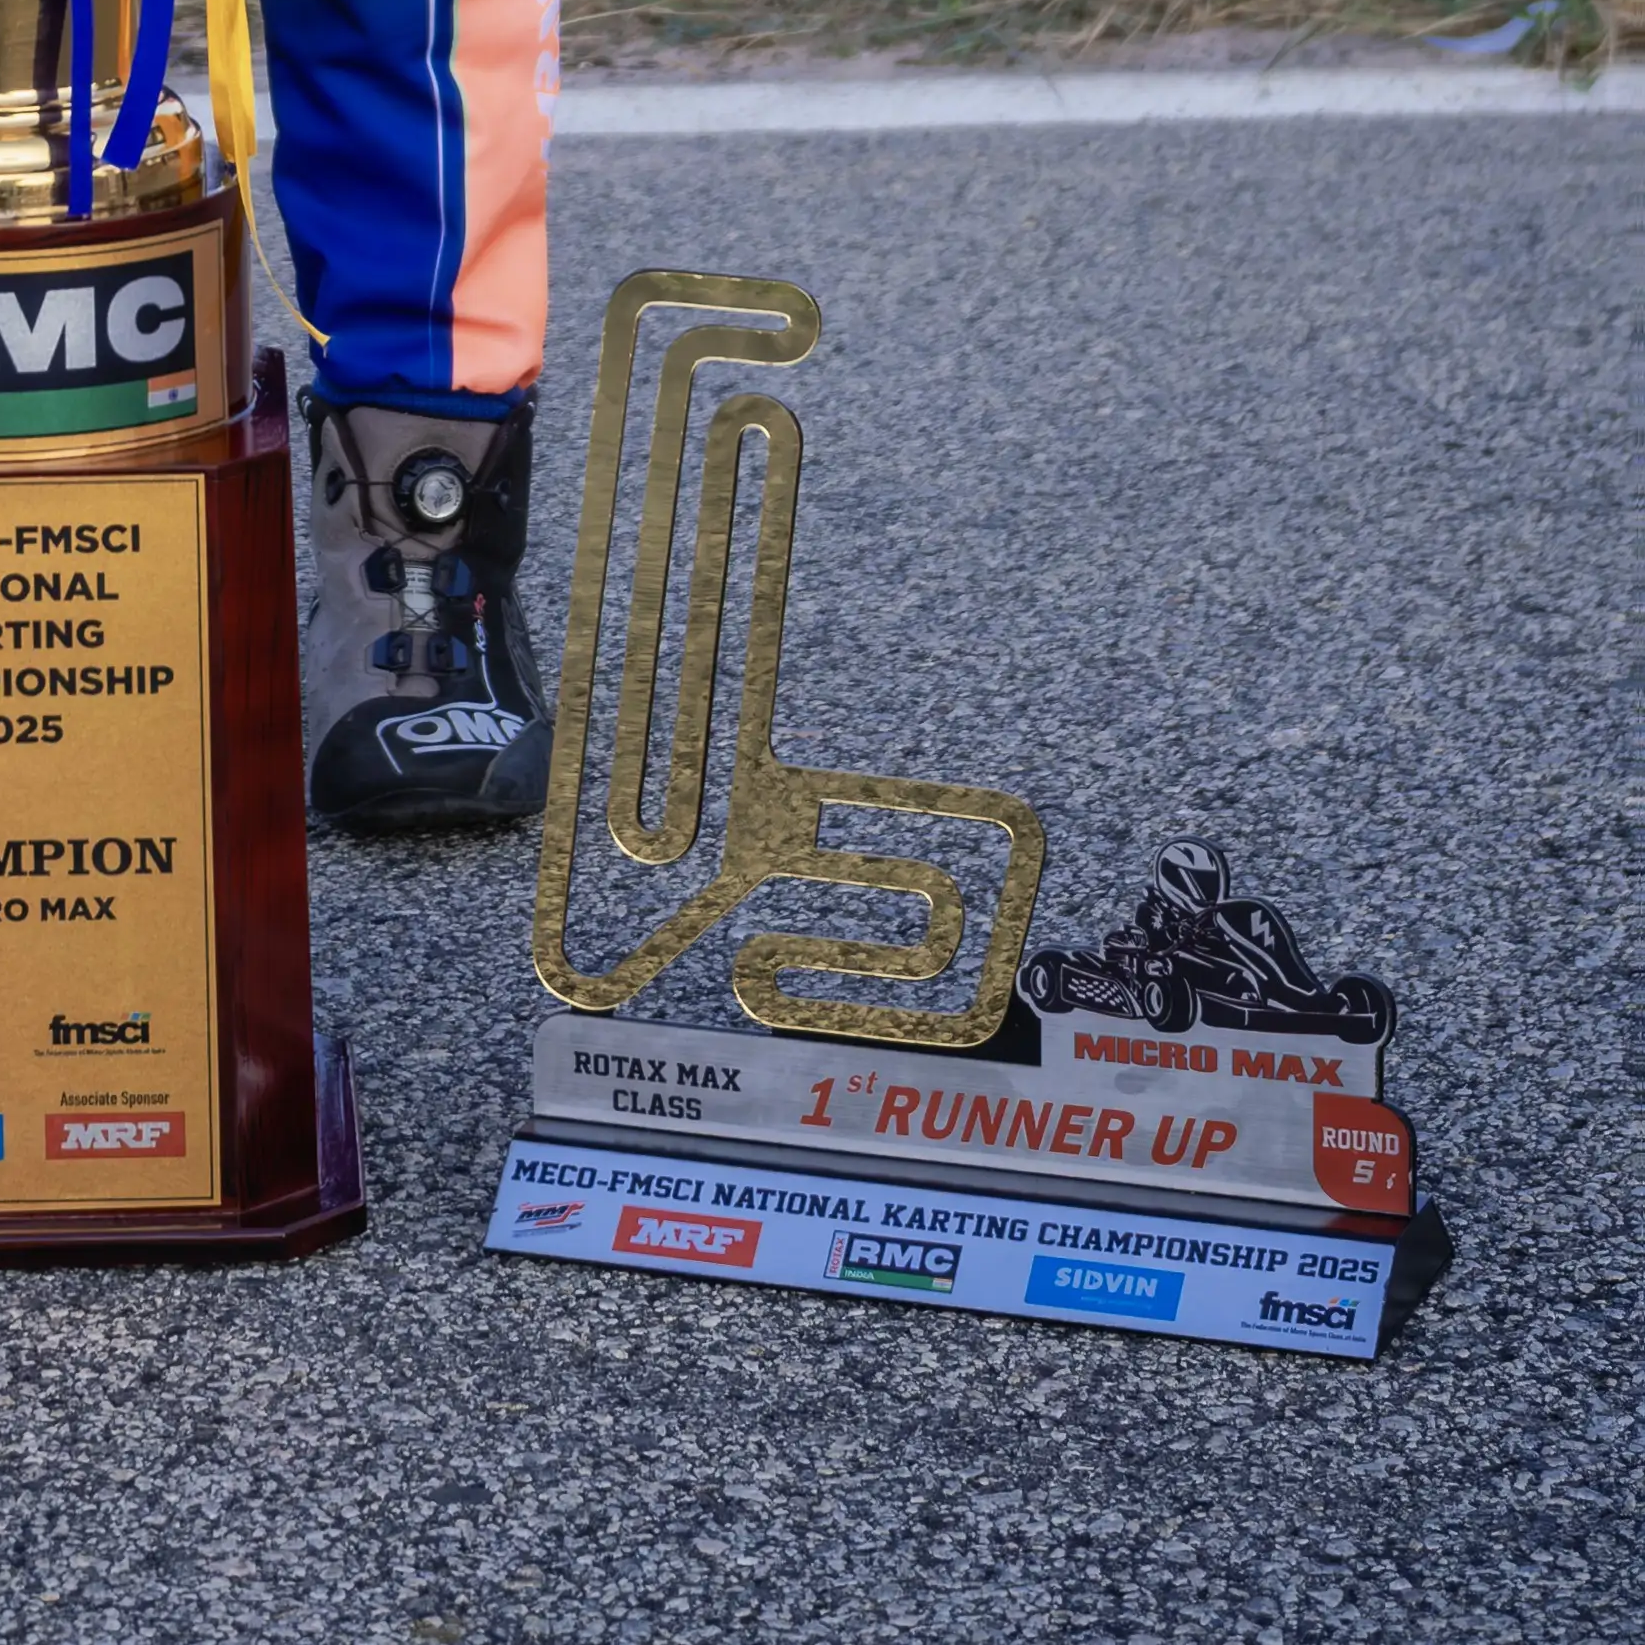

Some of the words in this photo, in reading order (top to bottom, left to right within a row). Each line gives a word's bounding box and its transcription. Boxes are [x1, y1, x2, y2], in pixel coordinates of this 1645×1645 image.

[40, 896, 117, 922] MAX
[48, 1011, 152, 1047] fmsci
[573, 1050, 668, 1084] ROTAX
[676, 1063, 742, 1092] MAX
[1073, 1032, 1219, 1074] MICRO
[1231, 1049, 1345, 1088] MAX
[59, 1091, 119, 1108] Associate
[121, 1091, 171, 1109] Sponsor
[612, 1088, 703, 1120] CLASS
[60, 1120, 171, 1150] MRF
[874, 1084, 1136, 1161] RUNNER
[1150, 1114, 1238, 1169] UP
[1321, 1125, 1400, 1156] ROUND
[511, 1158, 705, 1204] MECO-FMSCI
[711, 1183, 871, 1224] NATIONAL
[881, 1203, 1030, 1243] KARTING
[1037, 1221, 1289, 1274] CHAMPIONSHIP
[1296, 1252, 1381, 1285] 2025
[629, 1216, 745, 1255] MRF
[829, 1237, 846, 1276] ROTAX
[848, 1236, 956, 1274] RMC
[1053, 1266, 1159, 1299] SIDVIN
[1258, 1290, 1360, 1331] fmsci
